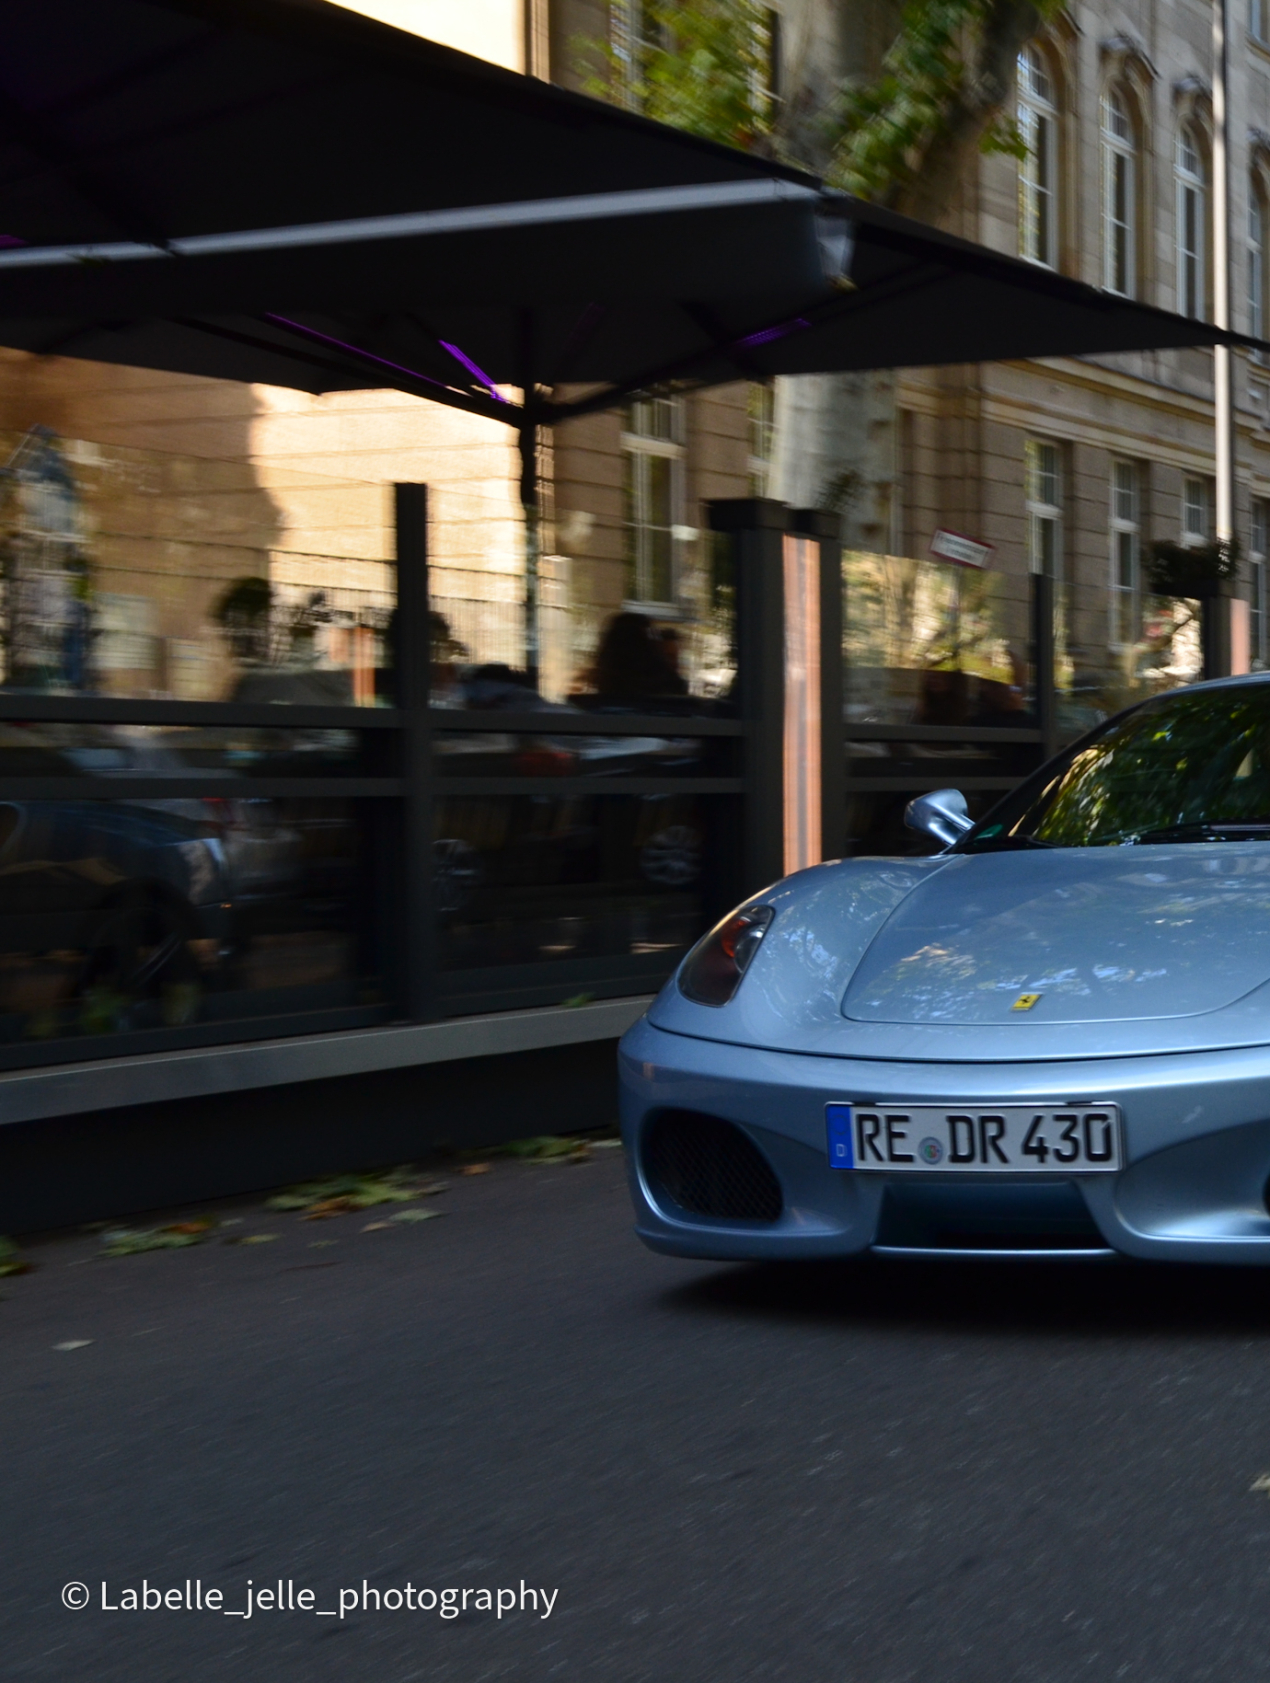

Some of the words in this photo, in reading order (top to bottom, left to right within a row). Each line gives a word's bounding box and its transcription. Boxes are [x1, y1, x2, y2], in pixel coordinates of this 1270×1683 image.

[836, 1143, 847, 1158] D
[856, 1113, 914, 1163] RE
[946, 1114, 1010, 1164] DR
[1021, 1113, 1112, 1164] 430
